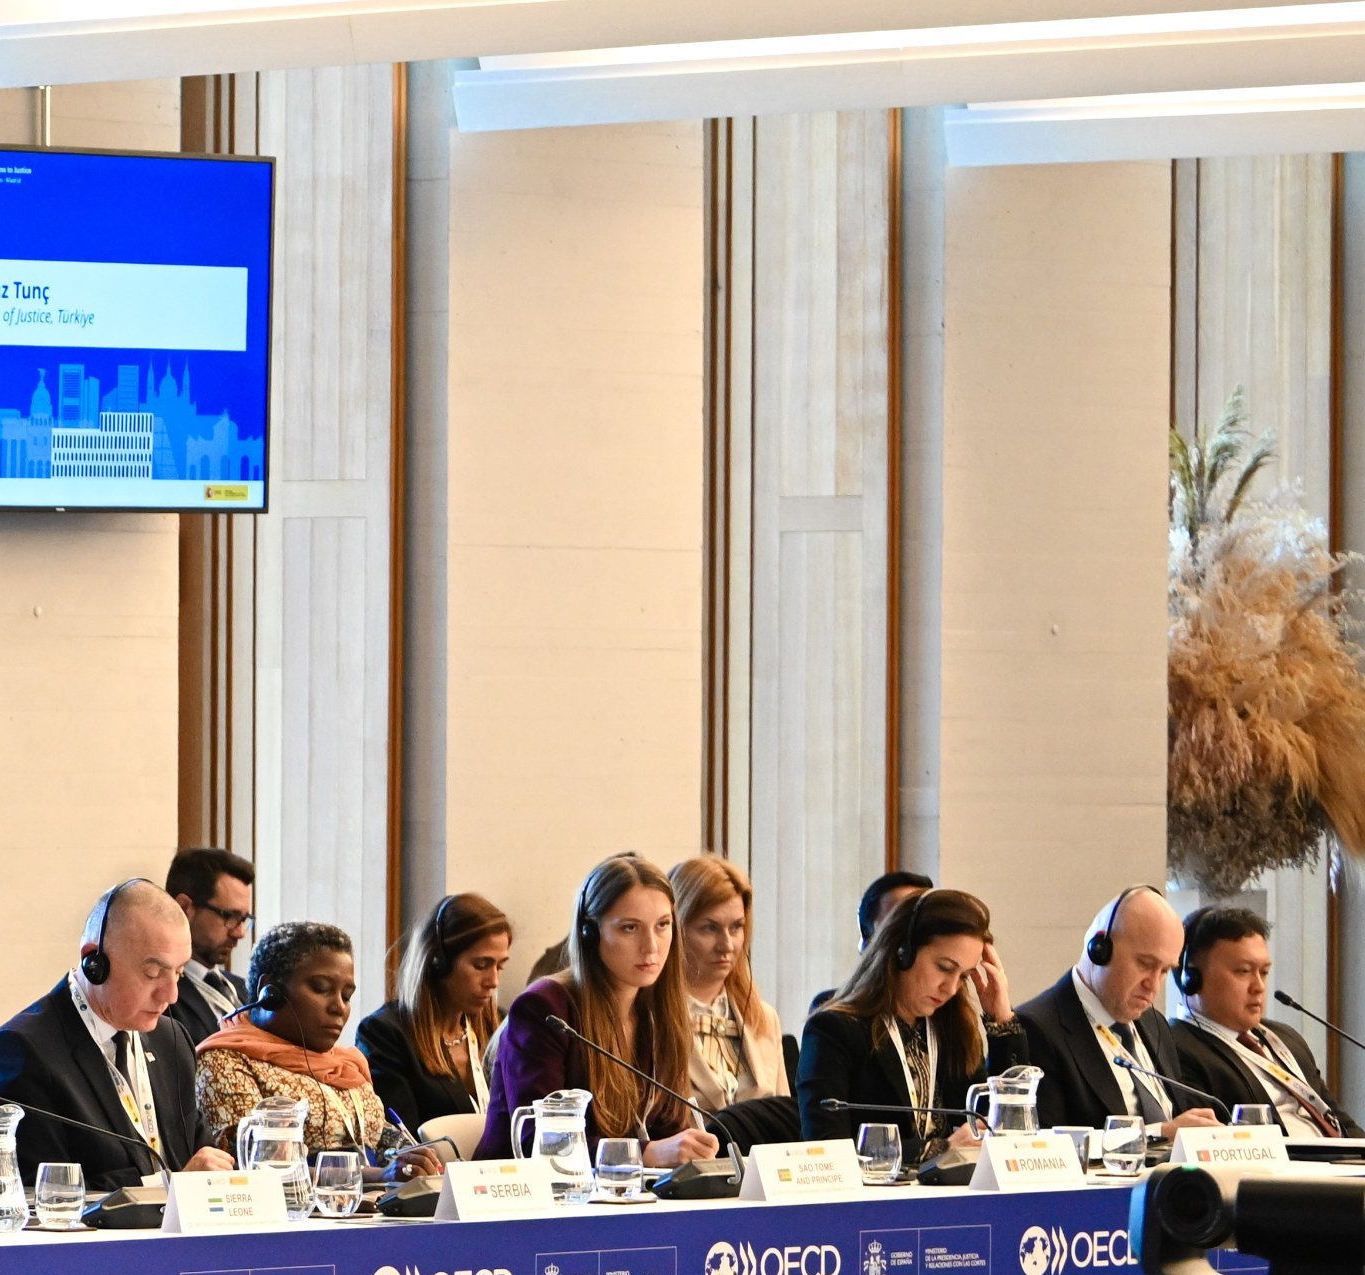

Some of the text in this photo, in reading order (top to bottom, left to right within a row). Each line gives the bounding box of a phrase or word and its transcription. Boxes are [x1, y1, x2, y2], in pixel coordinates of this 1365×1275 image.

[13, 281, 48, 304] Tunç
[3, 307, 15, 326] of
[15, 308, 53, 325] Justice,
[1213, 1148, 1277, 1161] PORTUGAL
[1019, 1157, 1067, 1171] ROMANIA
[490, 1183, 531, 1198] SERBIA
[225, 1194, 253, 1203] SIERRA
[229, 1207, 253, 1216] LEONE
